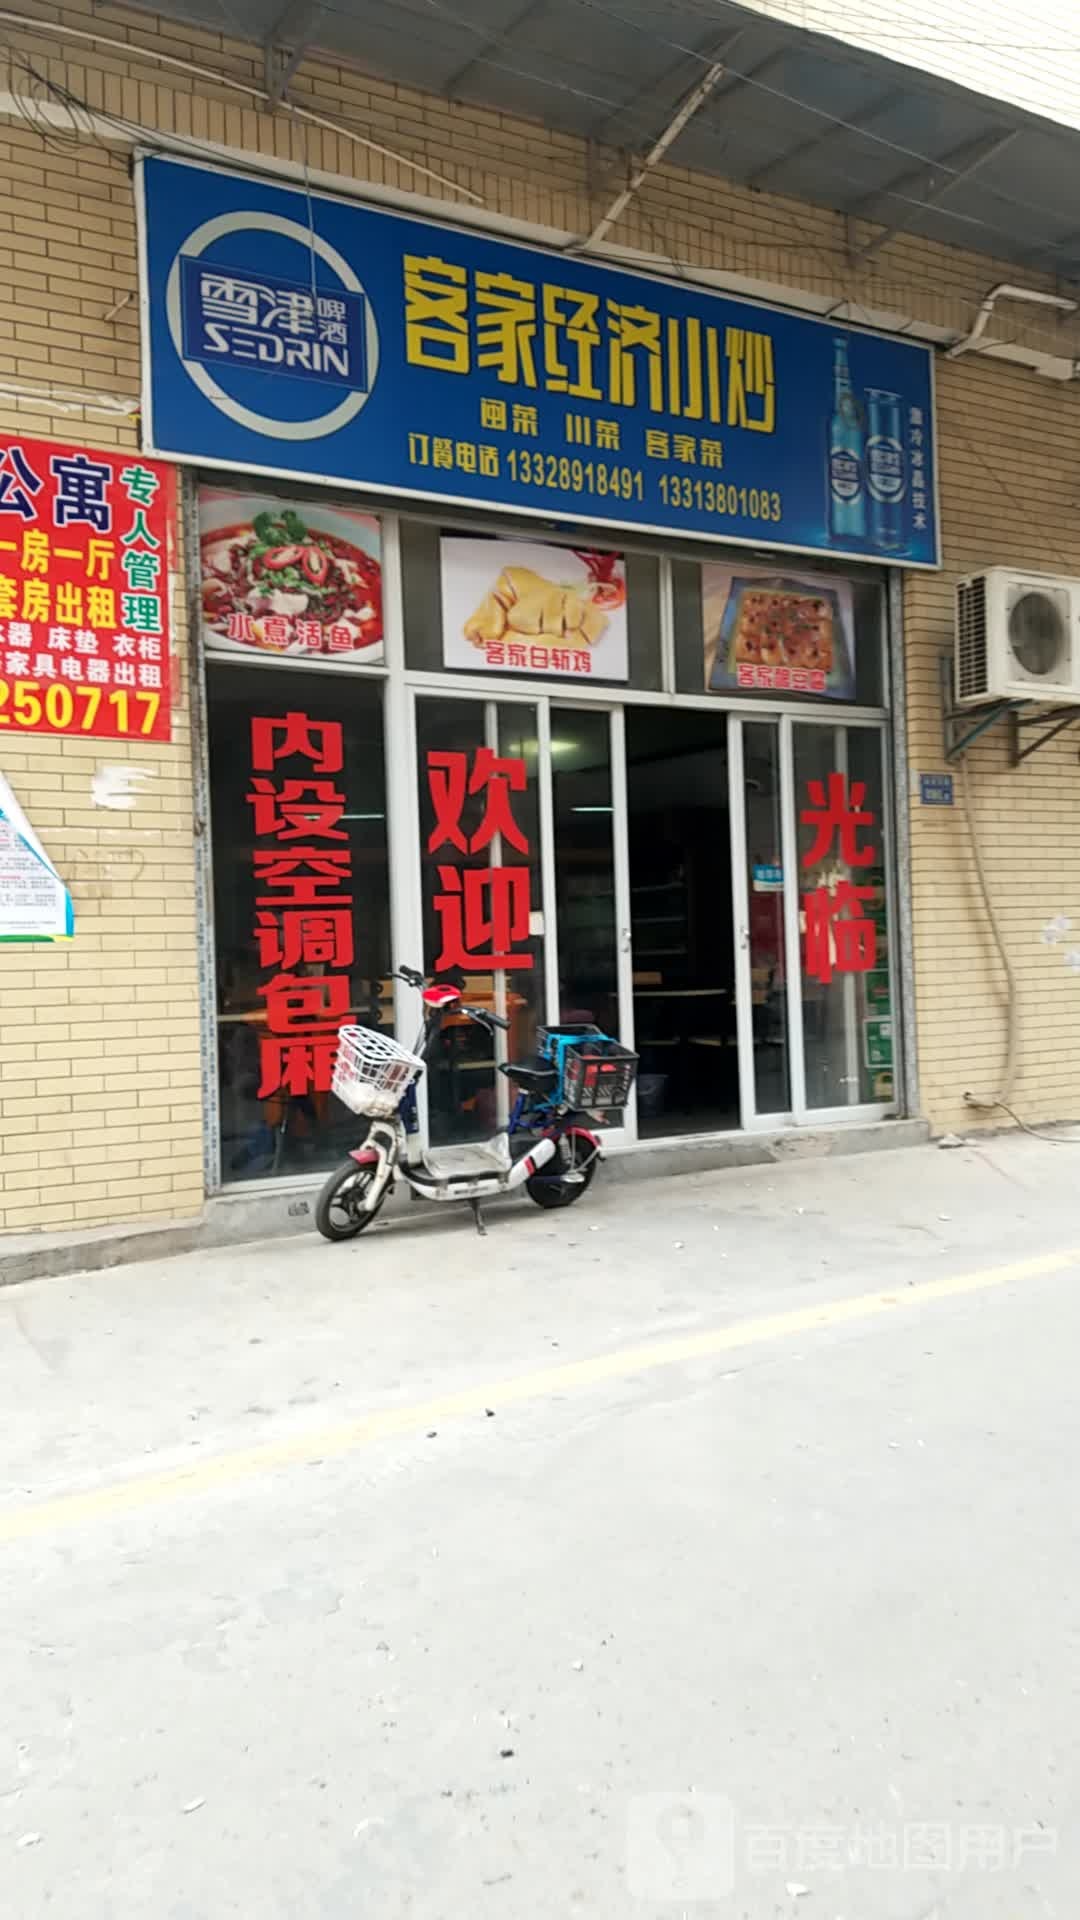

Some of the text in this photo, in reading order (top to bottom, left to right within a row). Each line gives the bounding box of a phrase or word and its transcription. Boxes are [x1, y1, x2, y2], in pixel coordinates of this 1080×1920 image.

[201, 273, 315, 335] 雪津
[317, 298, 347, 345] 啤酒
[203, 322, 349, 377] SEDRIN
[403, 254, 776, 434] 客家经济小炒
[480, 397, 725, 469] 闽菜 川菜 客家菜
[0, 447, 111, 531] 公寓
[408, 432, 783, 522] 订餐电话 13328918491 13313801083
[120, 466, 161, 632] 专人管理
[0, 621, 162, 661] 器 床垫 衣柜
[227, 613, 354, 650] 水煮活鱼
[485, 641, 592, 673] 客家白斩鸡
[0, 651, 162, 688] 家具电器出租
[426, 748, 534, 971] 欢迎
[801, 772, 877, 984] 光临
[246, 712, 358, 1099] 内设空调包厢
